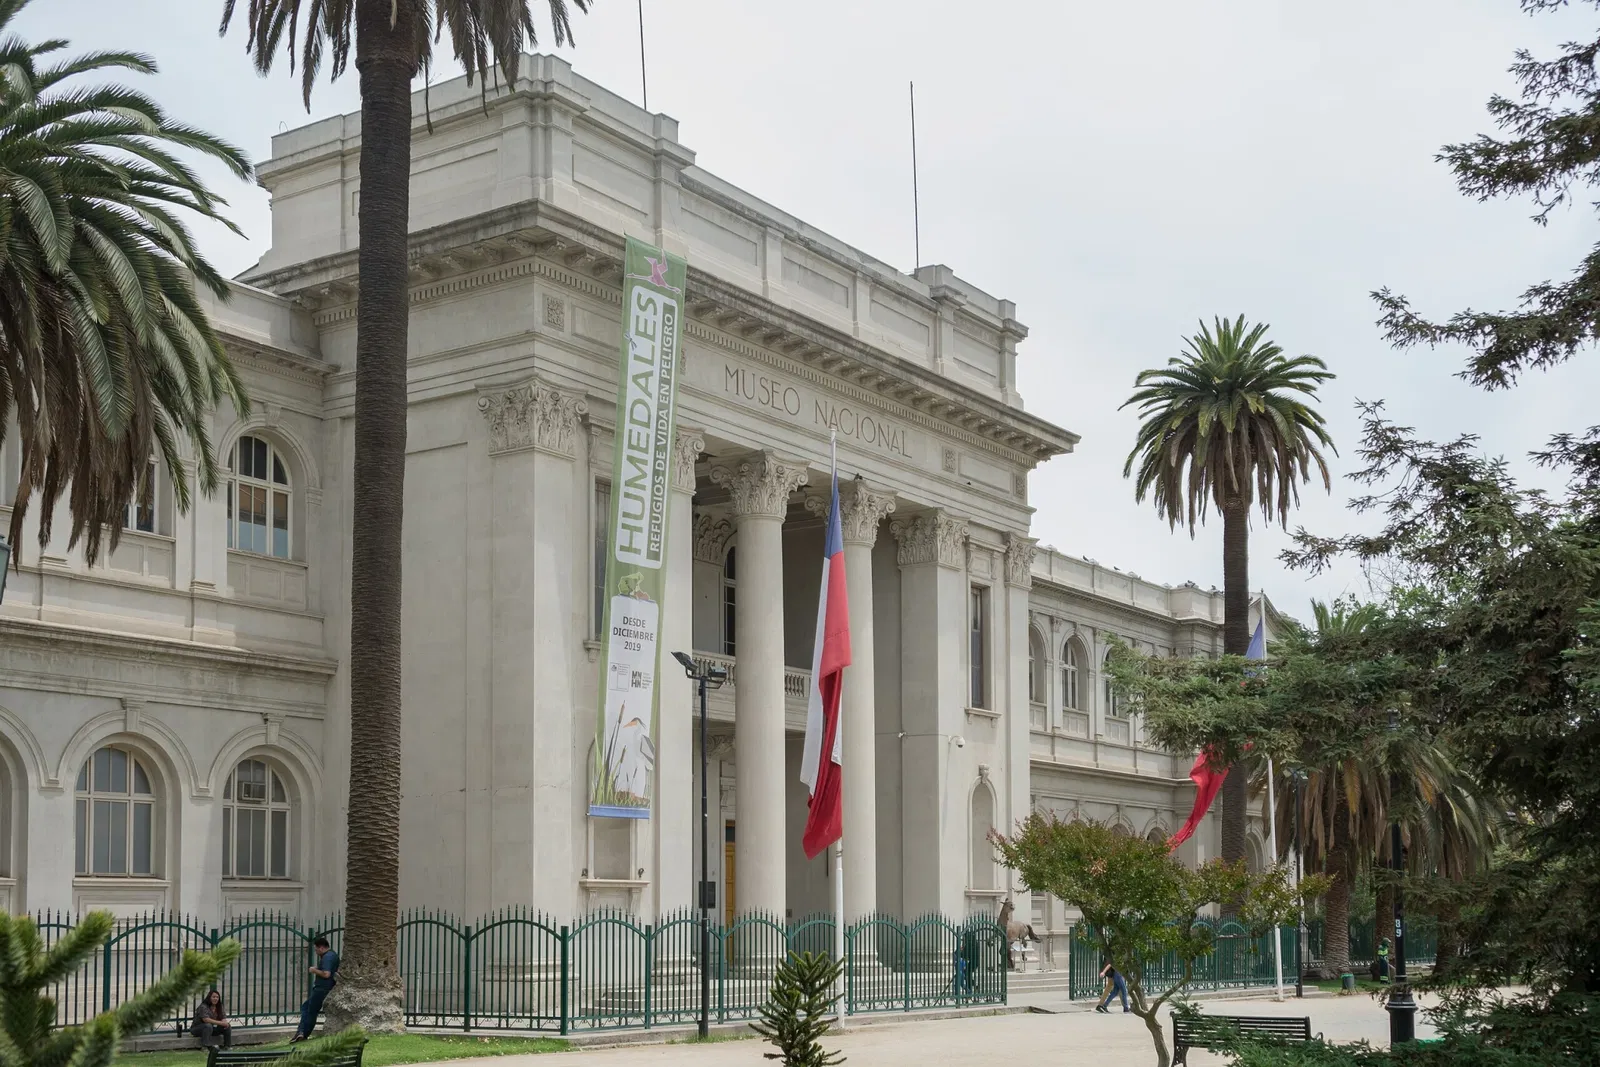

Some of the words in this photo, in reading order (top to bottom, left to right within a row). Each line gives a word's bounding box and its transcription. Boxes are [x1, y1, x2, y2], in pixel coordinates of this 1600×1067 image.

[661, 313, 673, 379] PELIGRO
[659, 385, 670, 403] EN
[618, 291, 659, 556] HUMEDALES
[724, 364, 801, 416] MUSEO
[814, 398, 913, 459] NACIONAL
[657, 409, 669, 445] VIDA
[655, 450, 666, 471] DE
[650, 475, 664, 552] REFUGIOS
[612, 627, 654, 642] DICIEMBRE
[622, 616, 646, 628] DESDE
[624, 641, 642, 652] 2019
